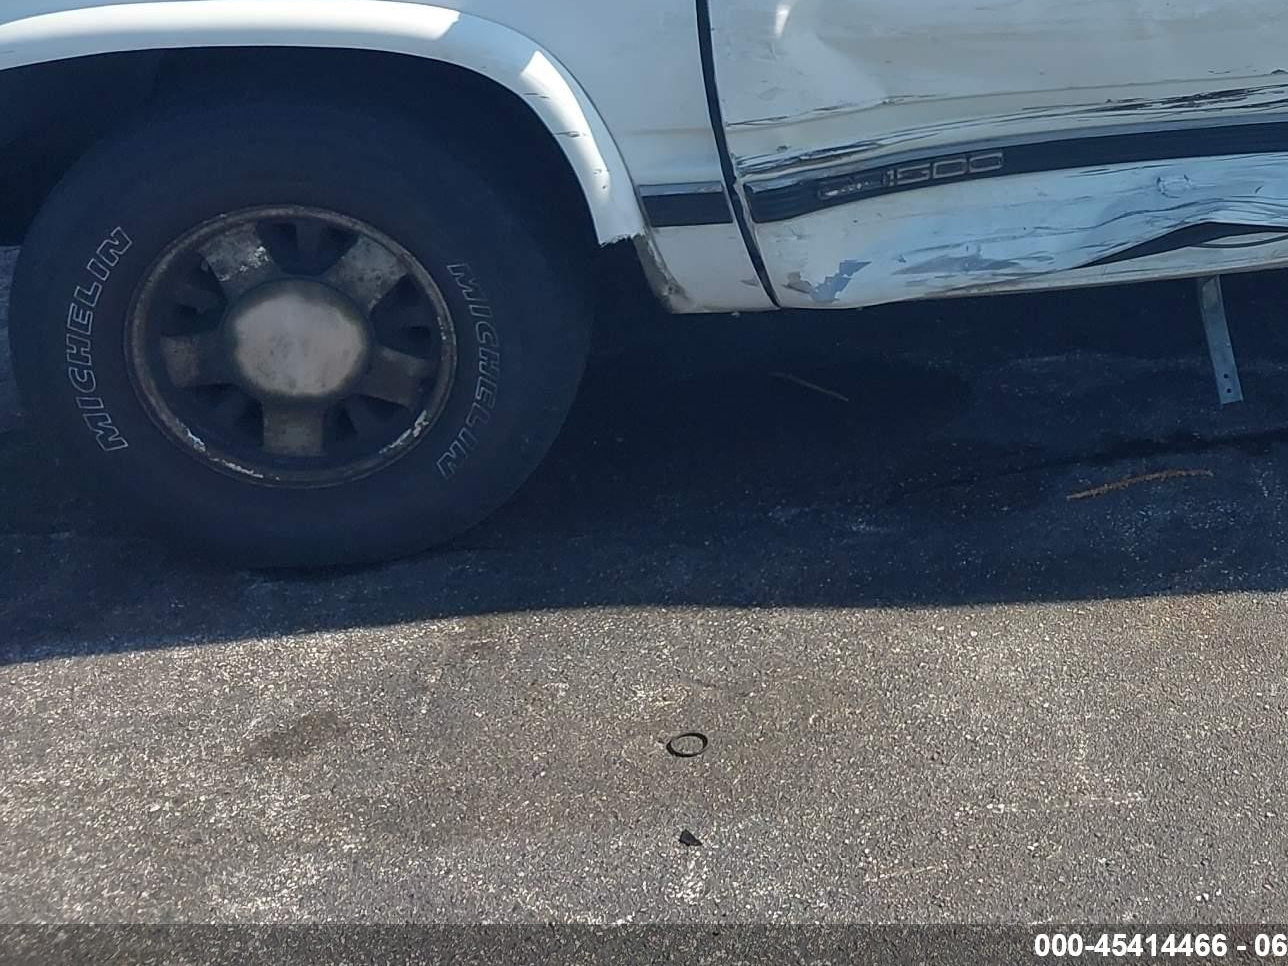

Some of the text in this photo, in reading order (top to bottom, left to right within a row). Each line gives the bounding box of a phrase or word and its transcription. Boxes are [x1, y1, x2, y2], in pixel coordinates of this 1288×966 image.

[884, 152, 1003, 186] 1500
[66, 226, 134, 452] MICHELIN
[436, 261, 500, 478] MICHELIN
